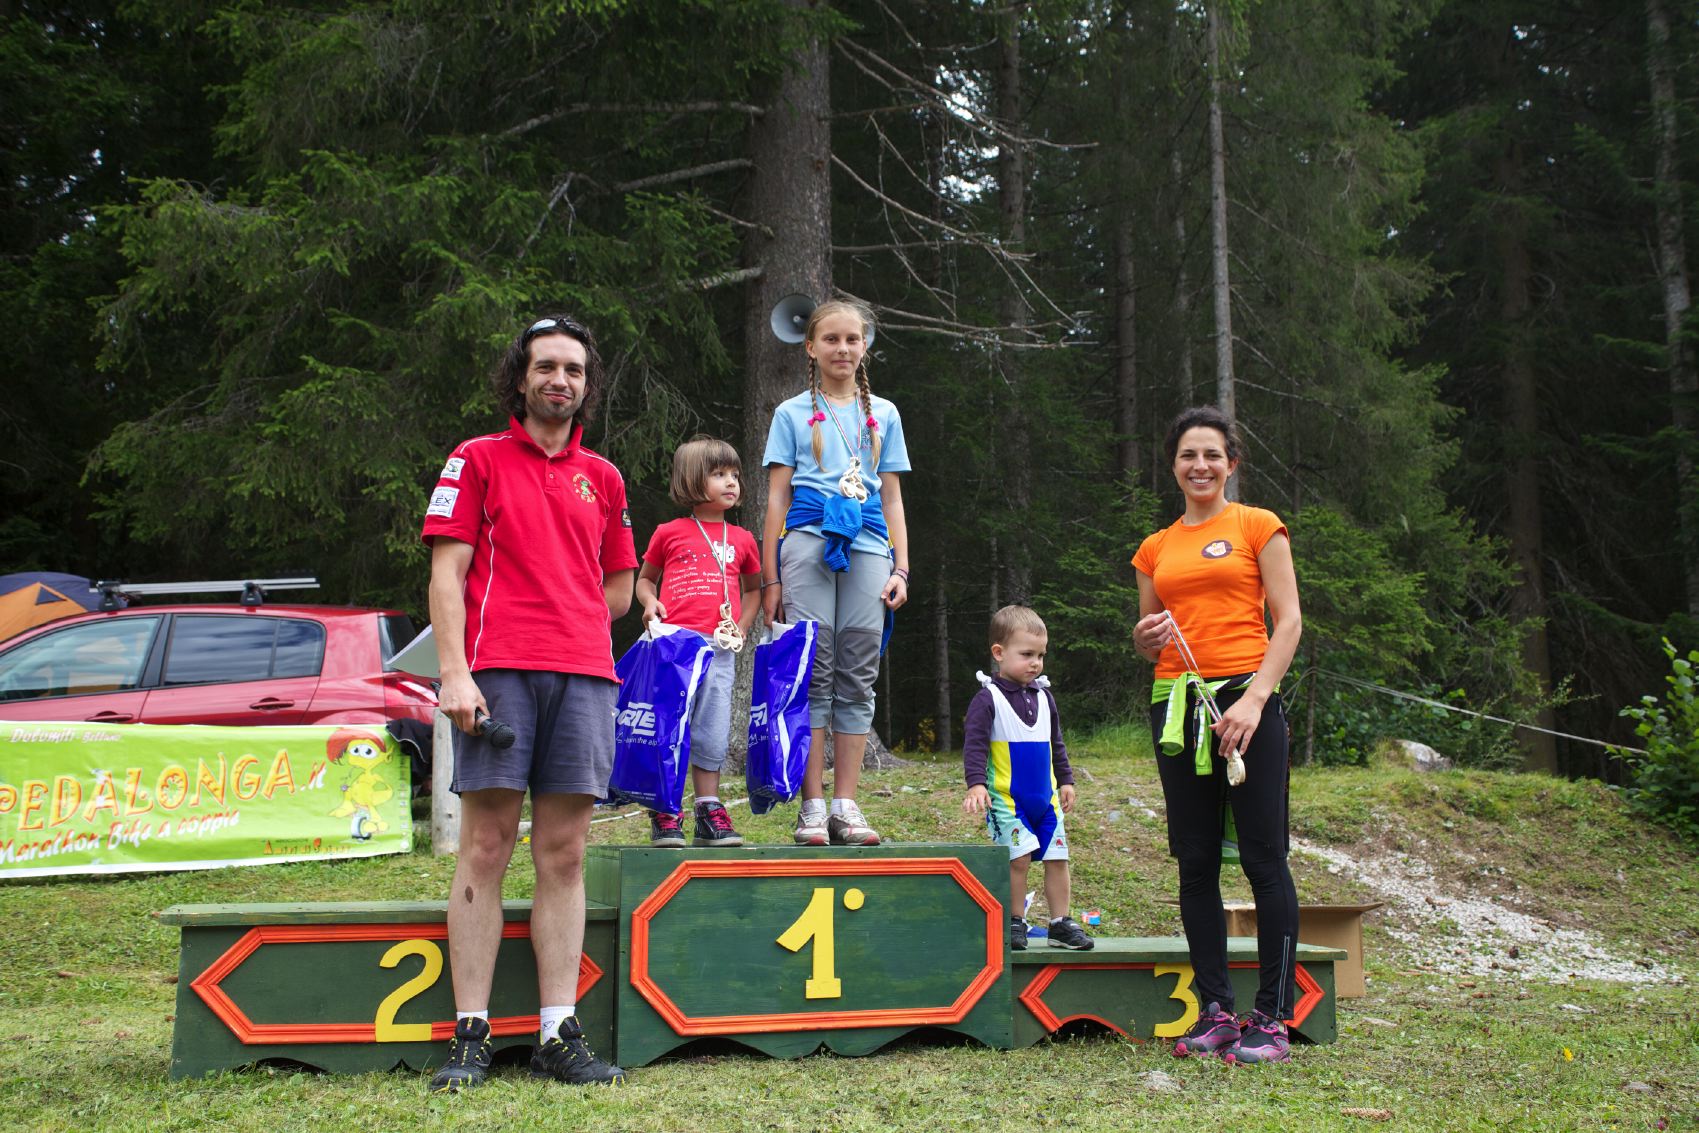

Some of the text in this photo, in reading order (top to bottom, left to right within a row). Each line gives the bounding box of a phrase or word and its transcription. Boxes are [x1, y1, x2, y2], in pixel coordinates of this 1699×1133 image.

[0, 829, 100, 864] Marathon
[375, 939, 444, 1042] 2
[1154, 963, 1199, 1038] 3
